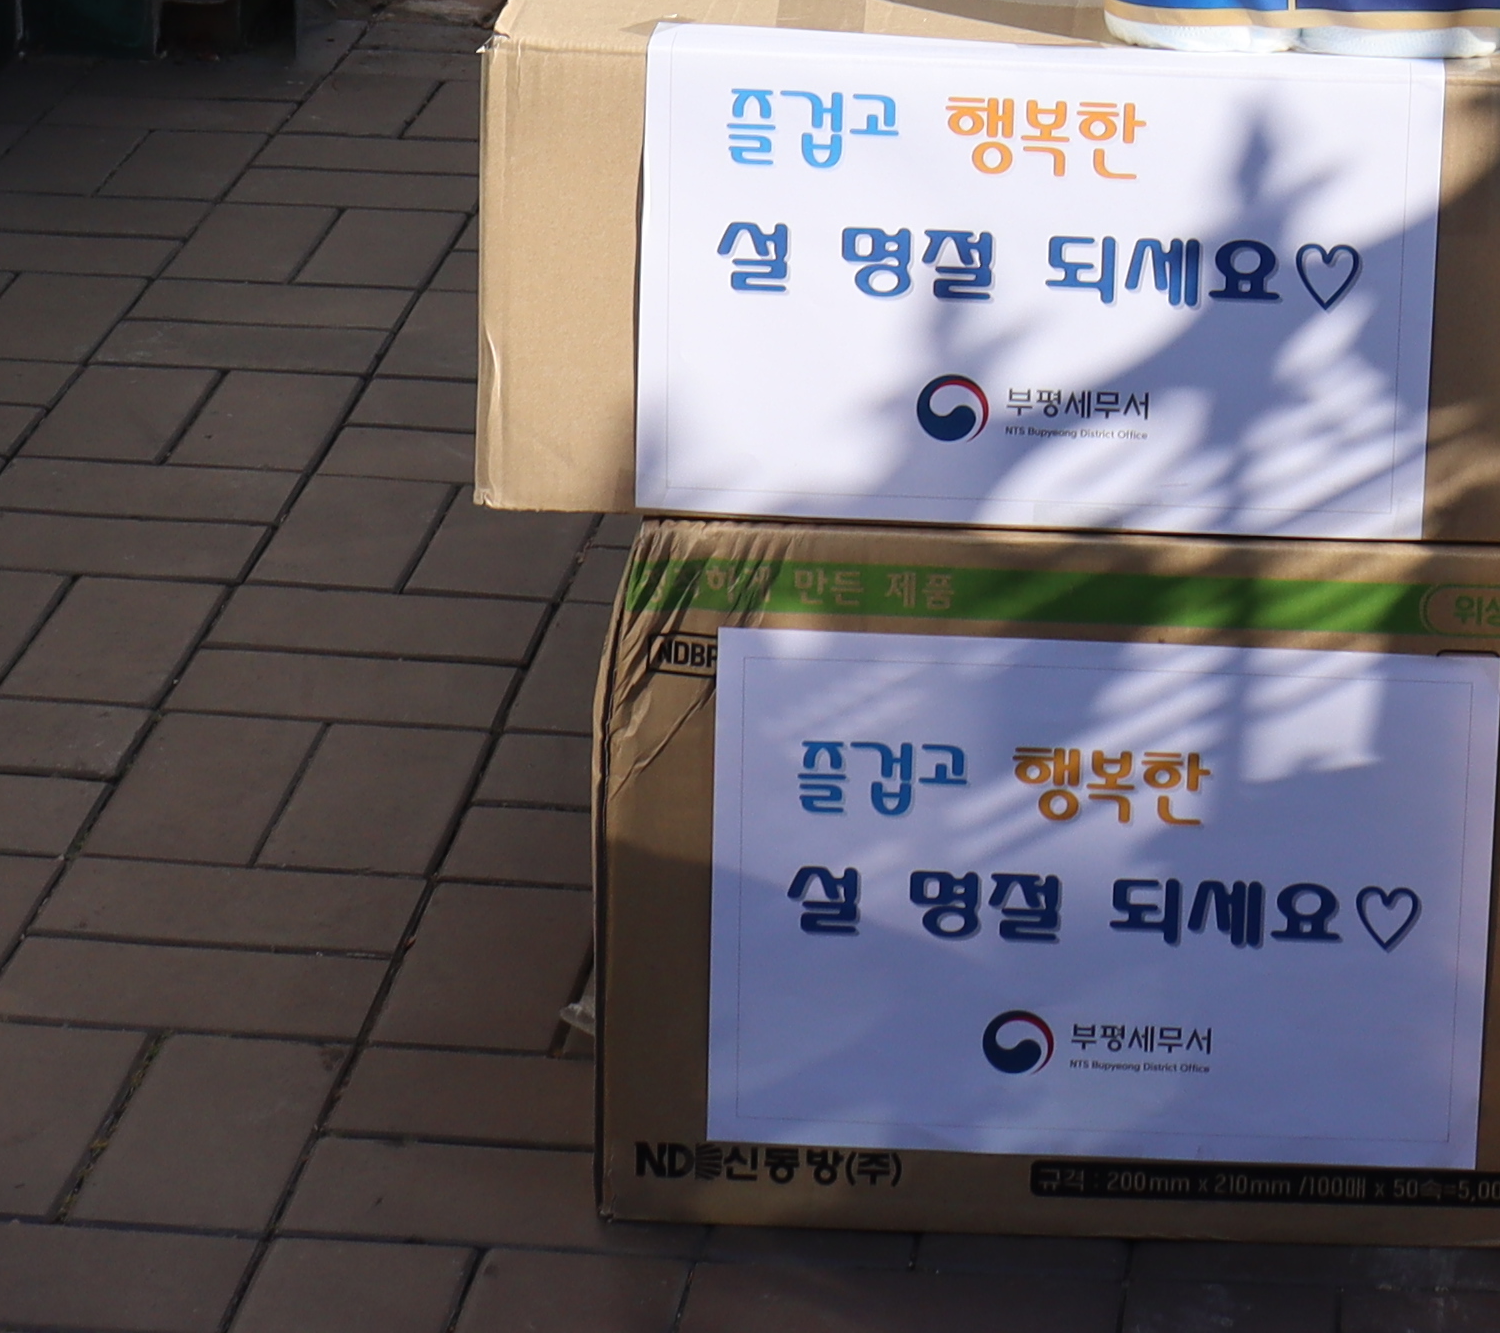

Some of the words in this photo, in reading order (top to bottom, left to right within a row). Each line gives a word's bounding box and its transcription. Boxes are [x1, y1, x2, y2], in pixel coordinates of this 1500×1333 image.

[726, 87, 899, 170] 즐겁고
[945, 96, 1146, 180] 행복한
[717, 221, 788, 292] 설
[841, 227, 993, 300] 명절
[1045, 236, 1282, 307] 되세요
[1006, 387, 1150, 421] 부평세무서
[1005, 426, 1025, 437] NTS
[1028, 426, 1078, 441] Bupyeong
[1081, 428, 1115, 440] District
[1117, 429, 1148, 441] Office
[794, 569, 864, 606] 만든
[885, 572, 956, 610] 제품
[797, 739, 967, 815] 즐겁고
[1012, 746, 1211, 825] 행복한
[787, 865, 859, 935] 설
[909, 870, 1059, 942] 명절
[1109, 877, 1340, 947] 되세요
[1071, 1023, 1213, 1055] 부평세무서
[1069, 1059, 1089, 1069] NTS
[1092, 1060, 1140, 1073] Bupyeong
[1143, 1062, 1177, 1072] District
[1180, 1064, 1210, 1074] Office
[634, 1141, 695, 1178] ND
[723, 1146, 903, 1188] 신동방(주)
[1040, 1169, 1085, 1193] 규격
[1107, 1171, 1190, 1195] 200mm
[1215, 1175, 1291, 1197] 210mm
